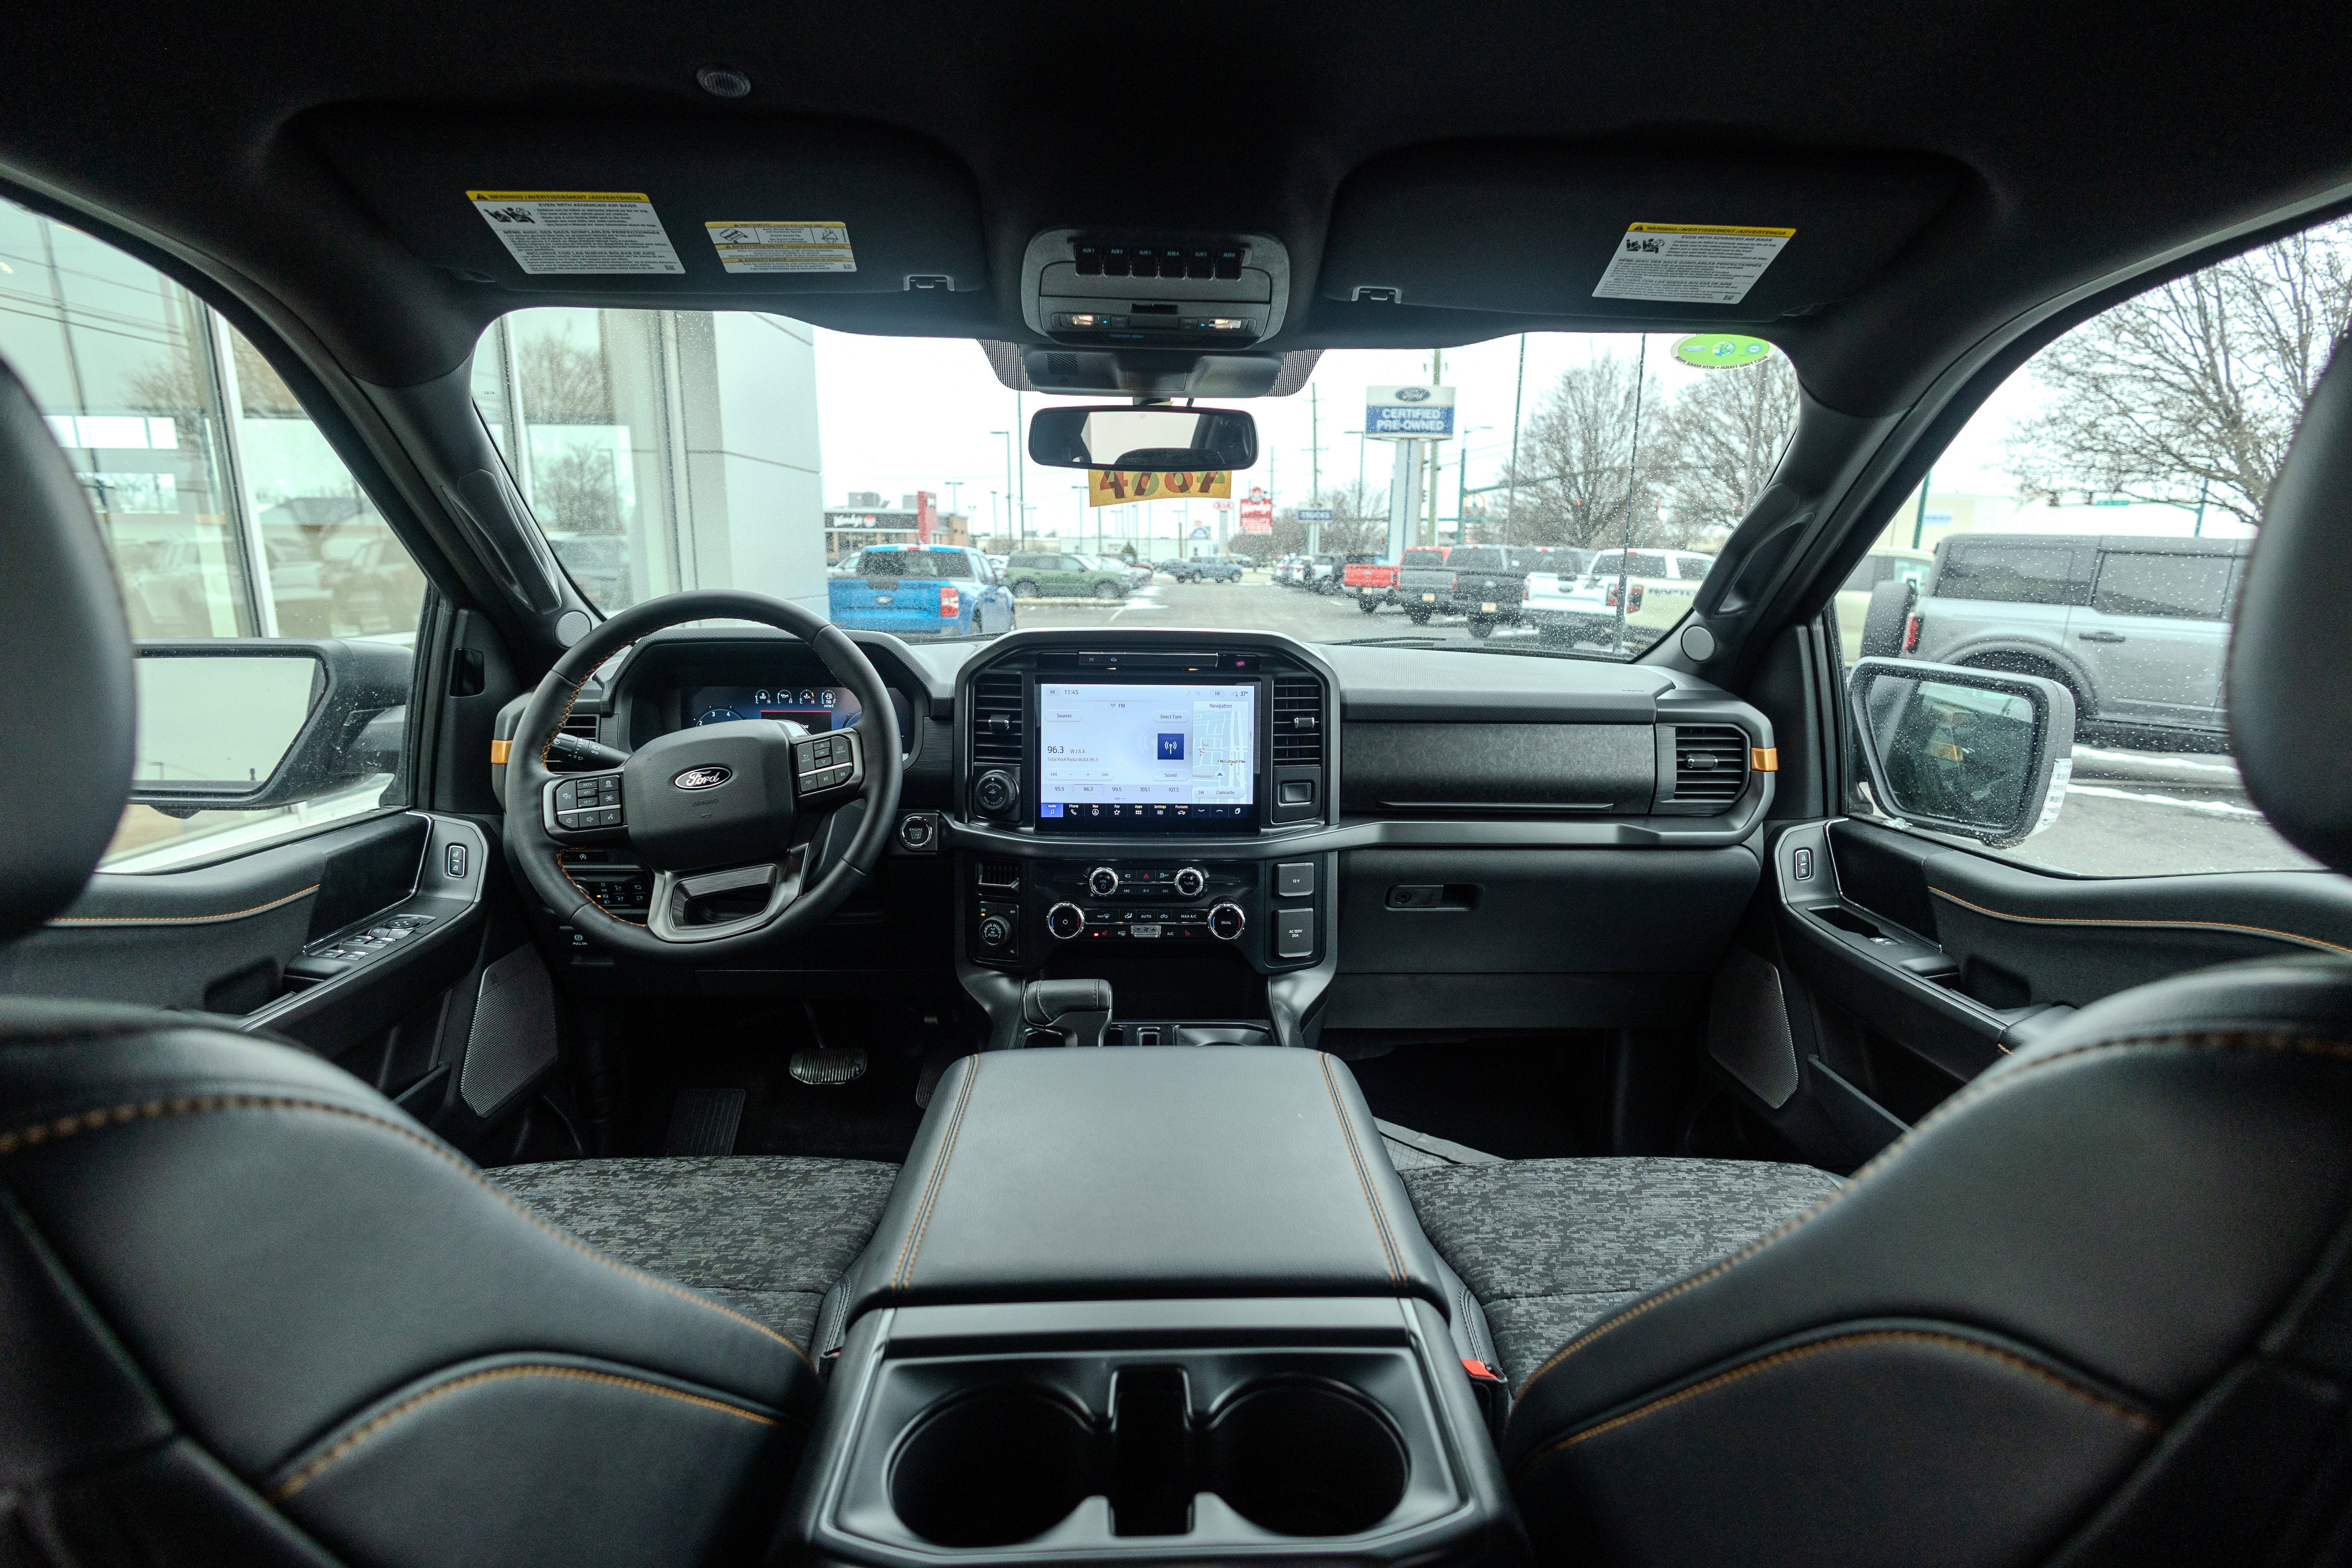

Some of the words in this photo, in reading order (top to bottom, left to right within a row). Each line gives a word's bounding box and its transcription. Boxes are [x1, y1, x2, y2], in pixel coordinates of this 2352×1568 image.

[1381, 408, 1441, 420] CERTIFIED
[1376, 419, 1445, 431] PRE-OWNED
[686, 770, 720, 786] Ford
[692, 798, 719, 806] AIRBAG
[990, 796, 1004, 805] TRAILER
[983, 923, 992, 933] DRIVE
[992, 923, 1002, 934] MODE
